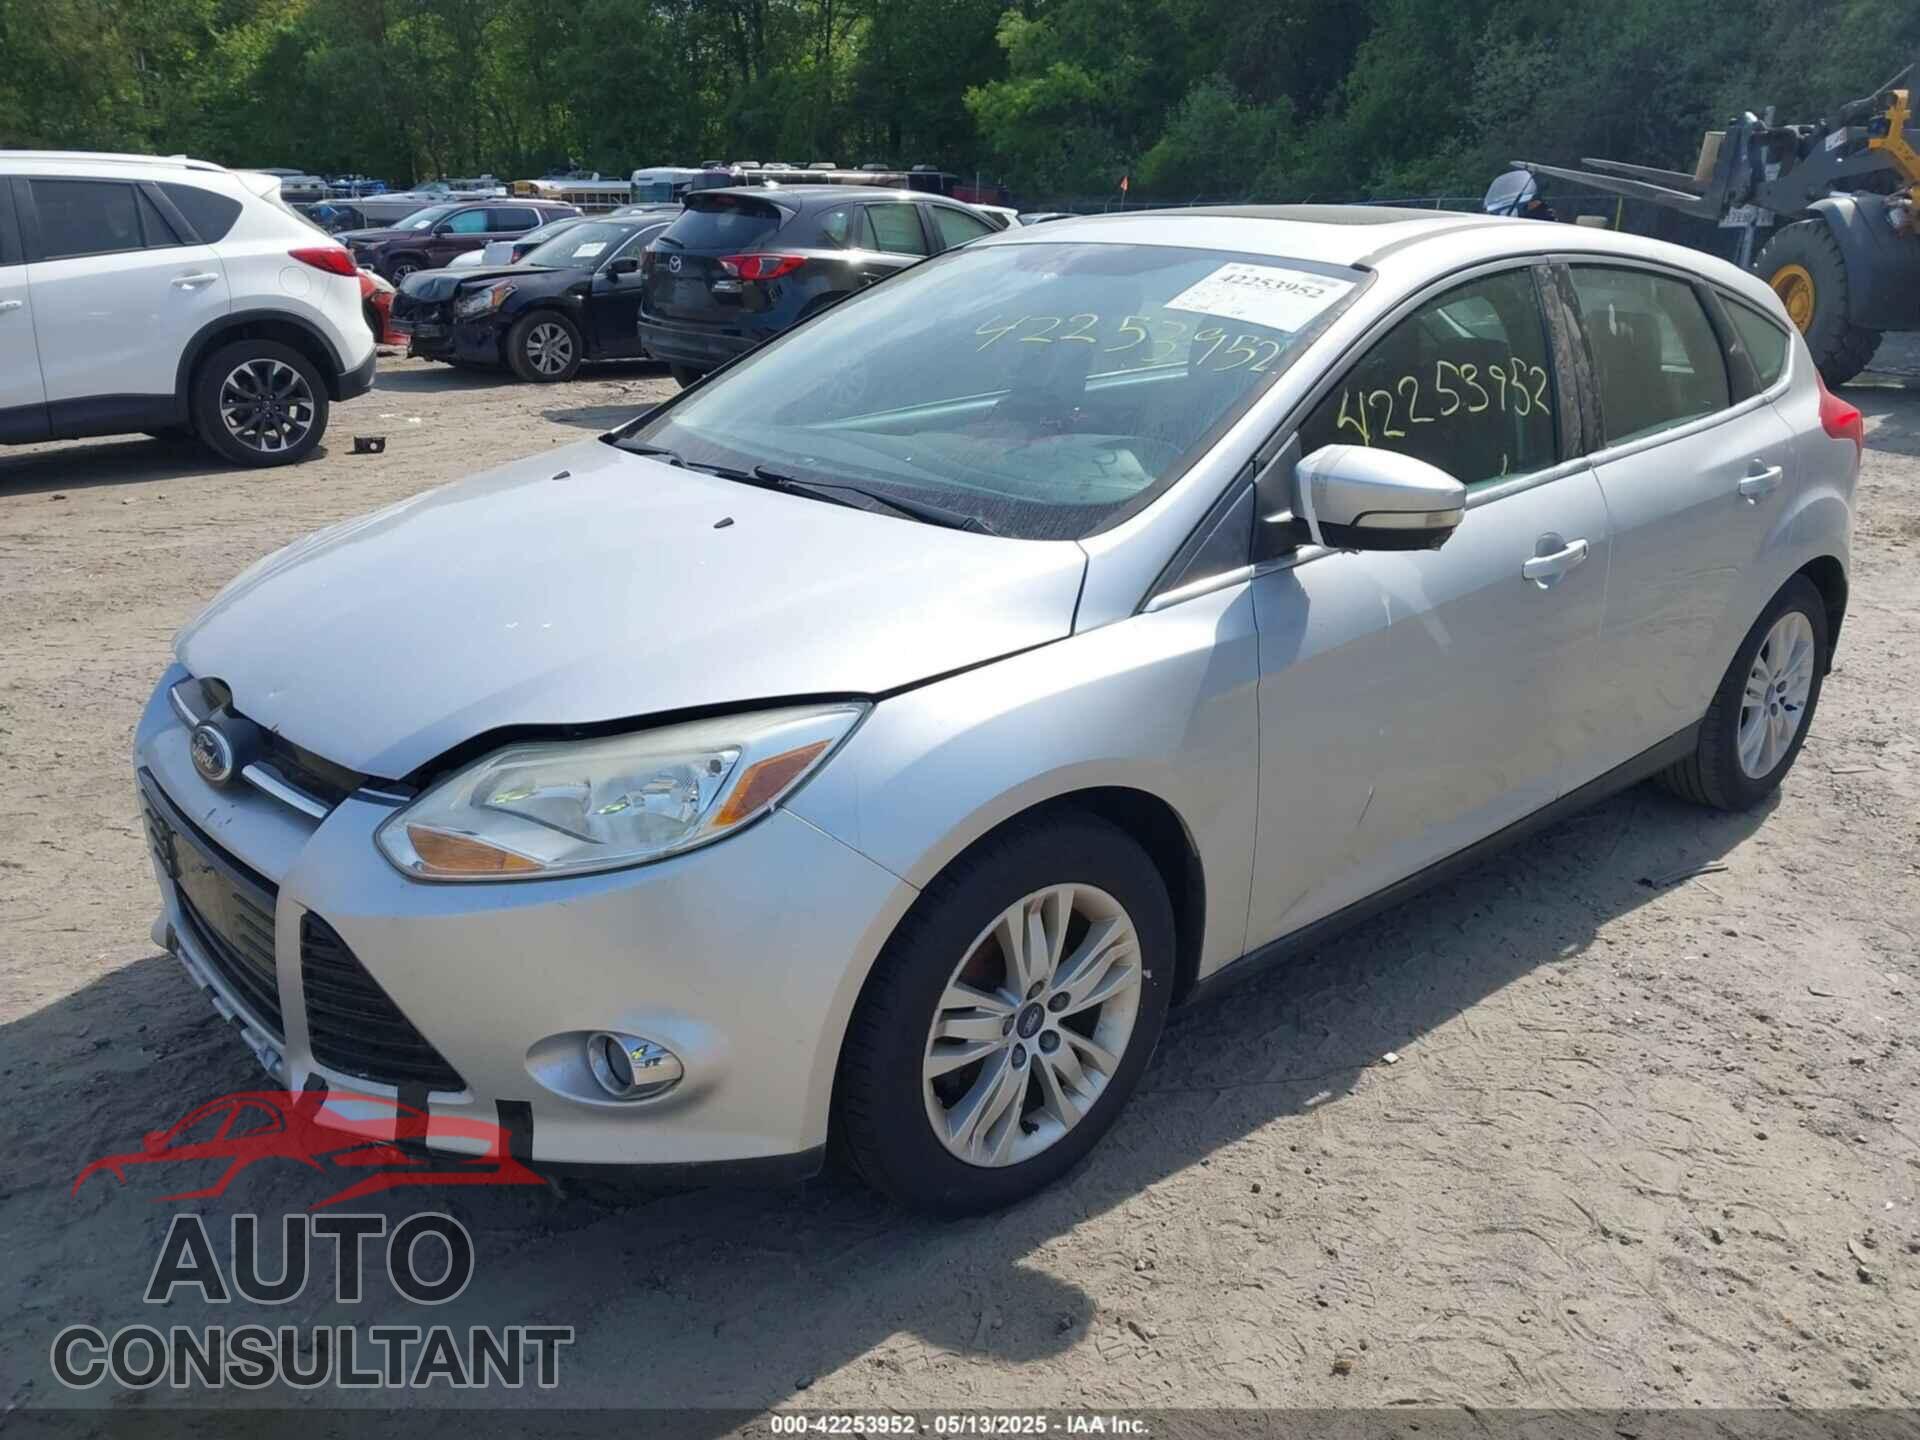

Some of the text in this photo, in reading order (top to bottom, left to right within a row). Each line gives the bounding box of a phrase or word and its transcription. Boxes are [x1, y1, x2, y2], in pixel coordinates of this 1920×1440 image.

[1219, 273, 1325, 299] 42253952
[975, 313, 1281, 372] 42253952
[1337, 357, 1551, 447] 42253952
